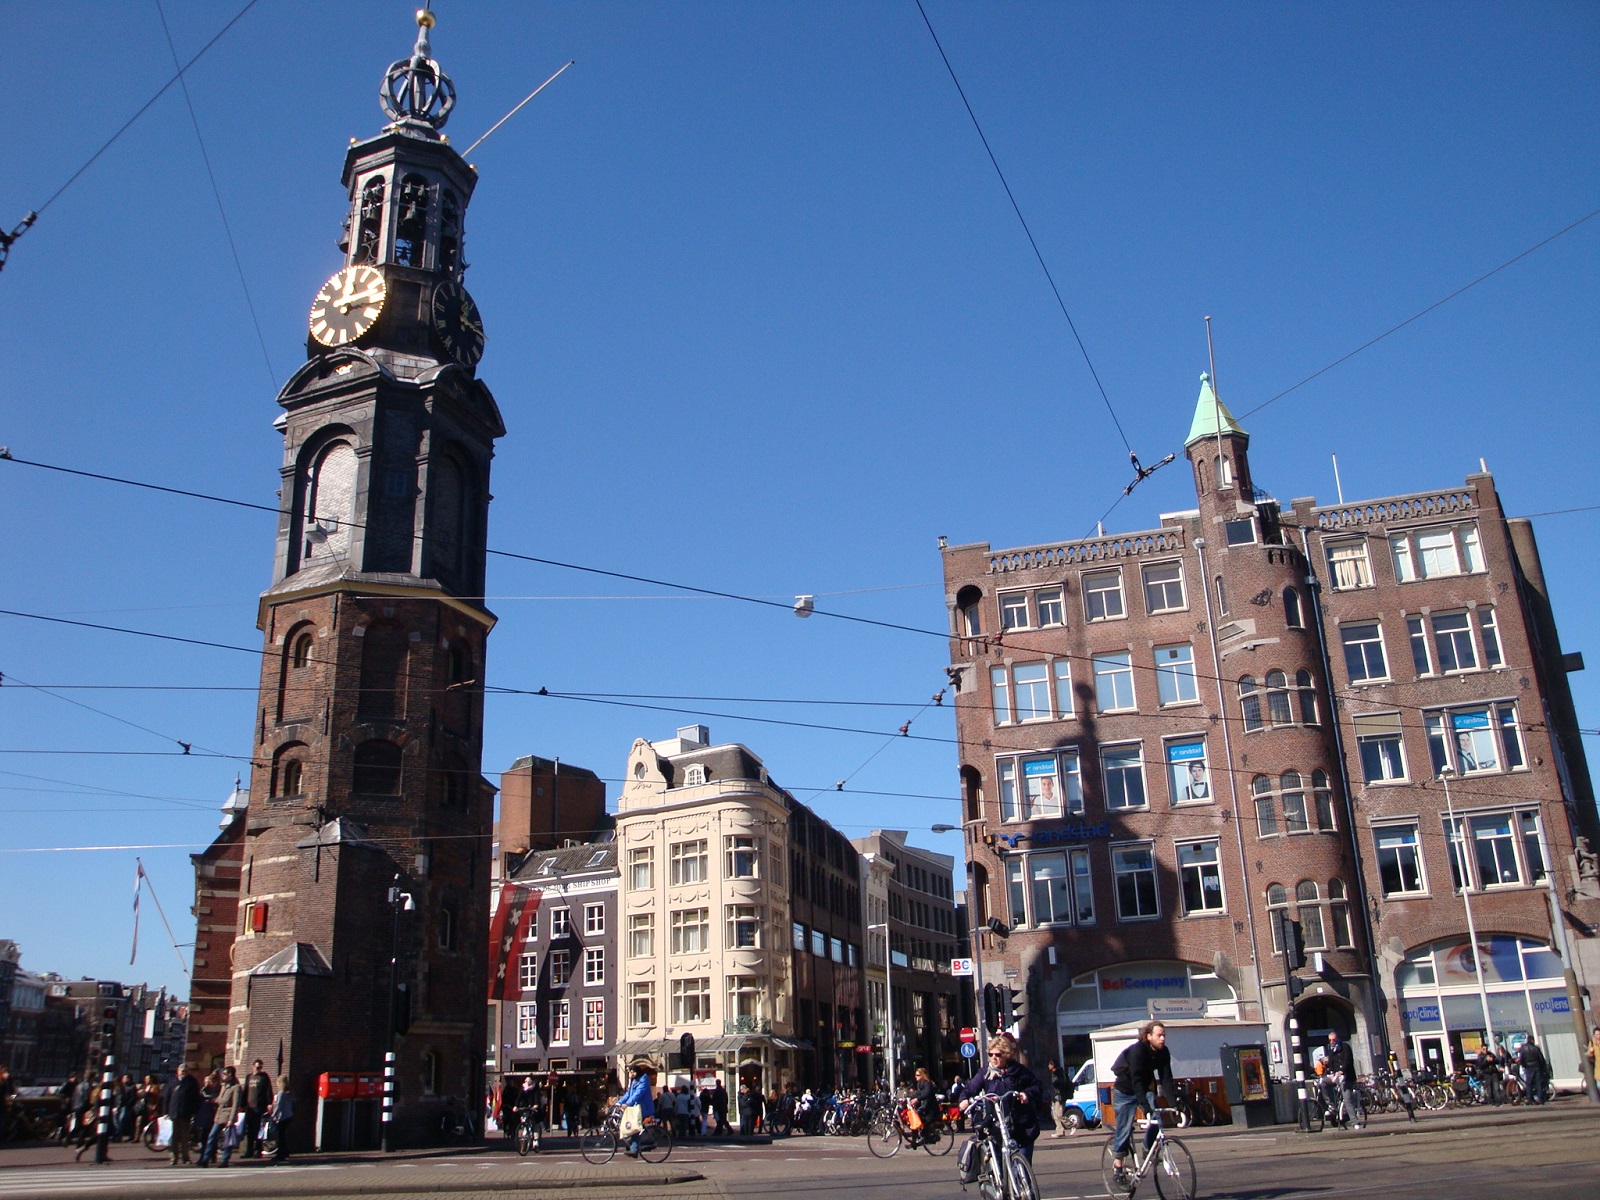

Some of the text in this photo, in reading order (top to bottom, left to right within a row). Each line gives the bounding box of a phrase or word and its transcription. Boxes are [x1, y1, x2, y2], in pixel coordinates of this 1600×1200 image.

[1179, 747, 1202, 755] randstad
[1032, 763, 1054, 771] randstad
[1032, 821, 1109, 842] randstad
[953, 960, 970, 971] BC
[1102, 977, 1185, 990] BelCompany
